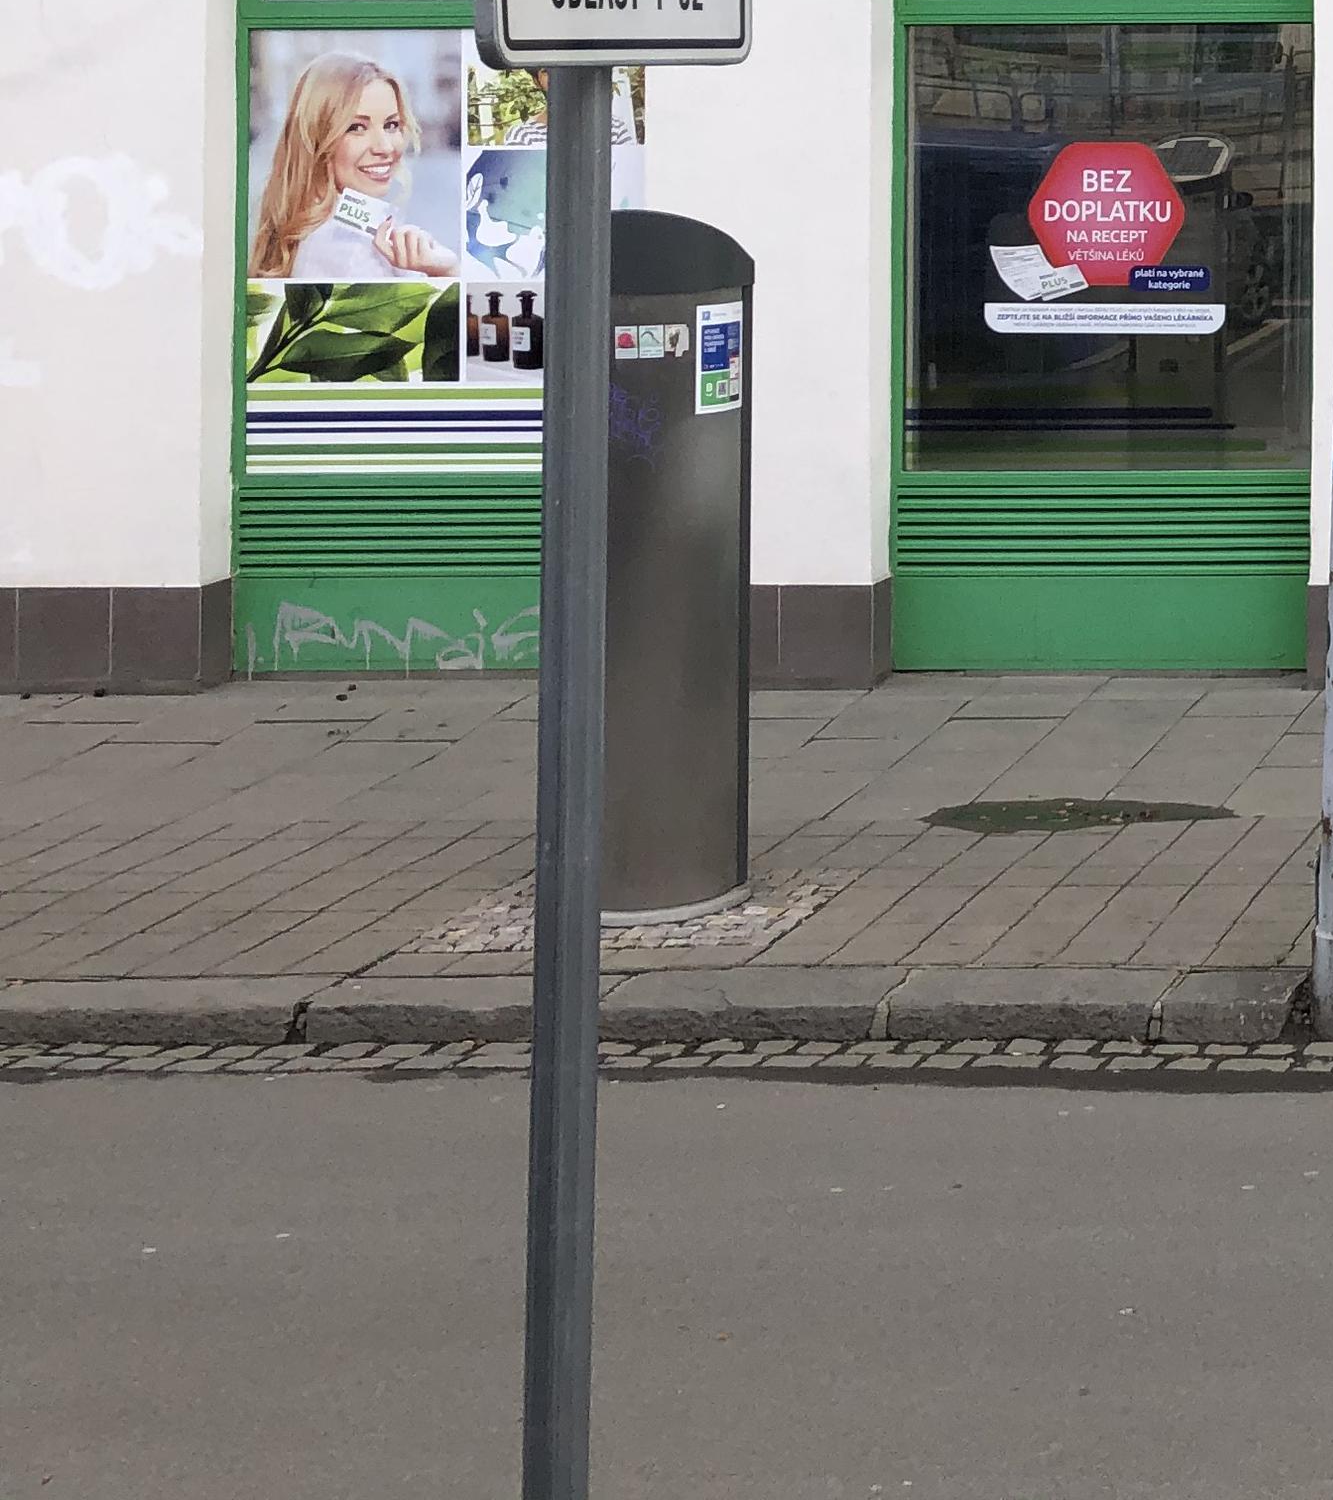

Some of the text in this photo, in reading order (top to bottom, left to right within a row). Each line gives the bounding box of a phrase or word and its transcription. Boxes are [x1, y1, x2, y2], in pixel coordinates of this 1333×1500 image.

[1082, 169, 1132, 193] BEZ
[339, 203, 371, 223] PLUS
[1044, 200, 1171, 223] DOPLATKU
[1066, 230, 1148, 243] NA RECEPT
[1068, 248, 1145, 262] VĚTŠINA LÉKŮ
[1135, 268, 1205, 280] platí na vybrané
[1041, 276, 1068, 290] PLUS
[1148, 280, 1191, 291] kategorie
